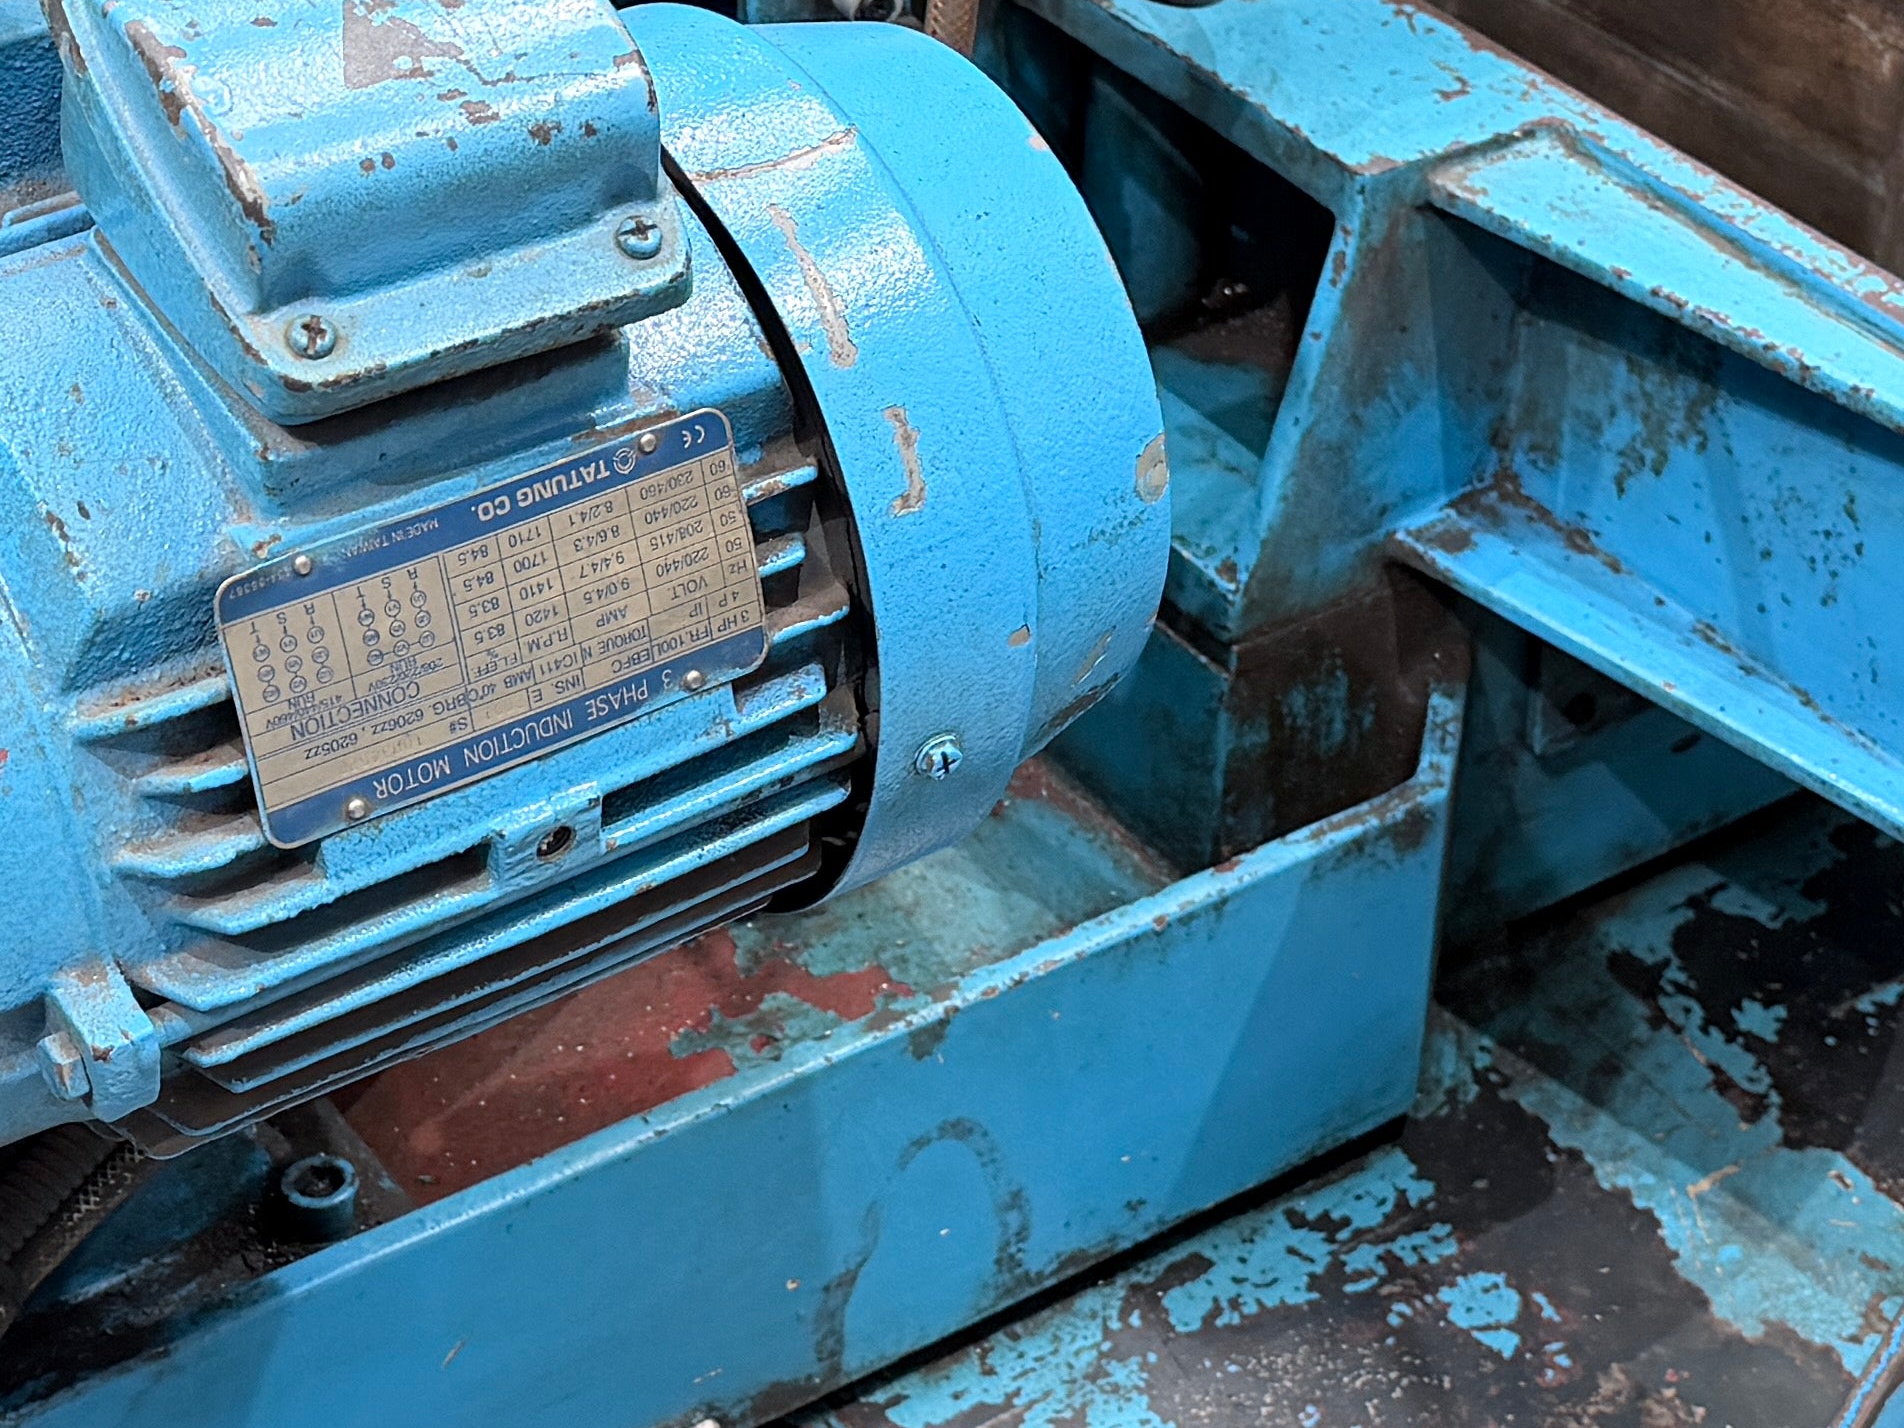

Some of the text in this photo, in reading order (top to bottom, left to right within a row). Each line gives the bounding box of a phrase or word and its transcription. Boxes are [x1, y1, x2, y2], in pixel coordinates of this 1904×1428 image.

[469, 457, 611, 525] TATUNG CO.
[405, 516, 439, 538] MADE
[455, 458, 726, 567] 60 230/460 8.2/4.1 1710 84.5
[461, 483, 731, 594] 60 220/440 8.6/4.3 1700 84.5
[467, 508, 737, 619] 50 208/415 9.4/4.7 1410 83.5
[727, 558, 747, 575] Hz
[352, 566, 418, 600] R S T
[472, 535, 743, 646] 50 220/440 9.0/4.5 1420 83.5
[666, 573, 708, 601] VOLT.
[716, 589, 740, 608] 4 P
[246, 600, 316, 636] R S T
[593, 603, 629, 629] AMP
[686, 601, 703, 618] IP
[715, 608, 750, 634] 3 HP
[596, 624, 647, 655] TORQUE
[651, 624, 709, 657] FR.100L
[538, 650, 579, 677] IC411
[609, 646, 651, 674] EBFC
[501, 666, 534, 690] AMB
[530, 672, 581, 704] INS. E
[660, 667, 674, 690] 3
[288, 678, 421, 743] CONNECTION
[427, 690, 467, 718] BRG.
[583, 677, 649, 721] PHASE
[447, 714, 469, 735] S#
[461, 707, 573, 768] INDUCTION
[371, 753, 451, 802] MOTOR
